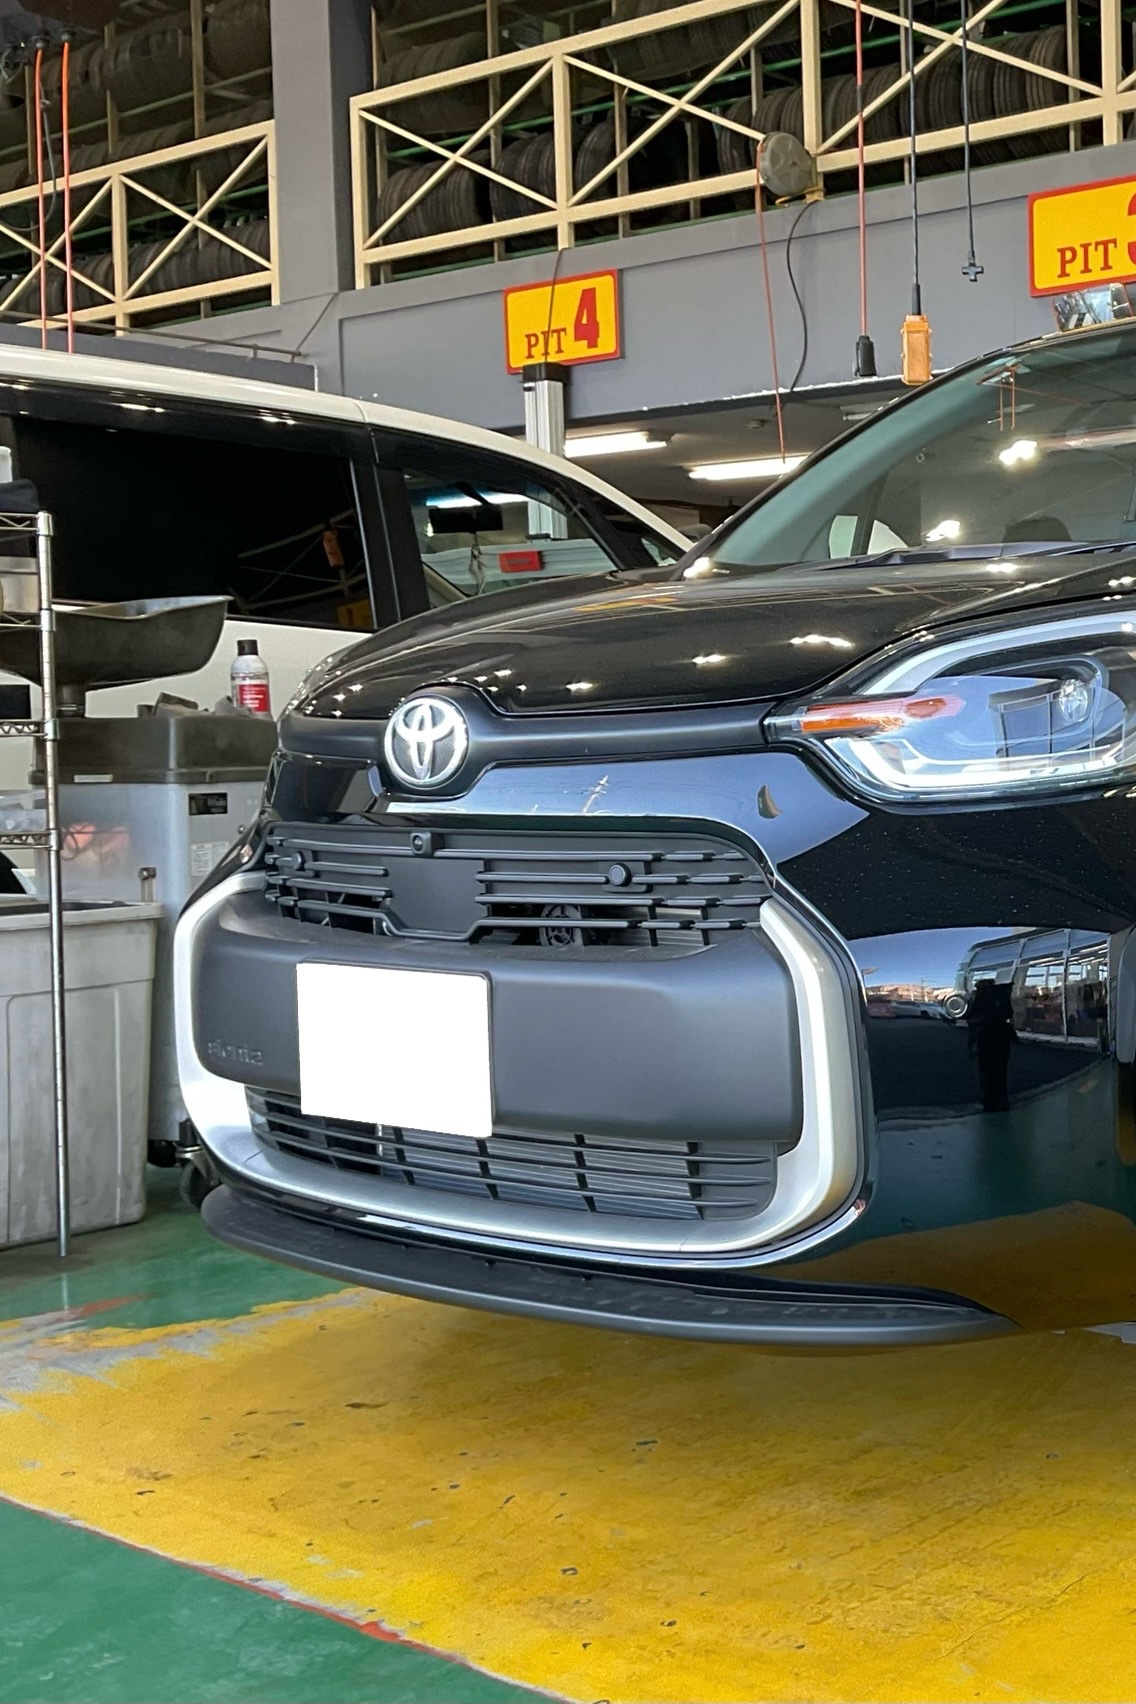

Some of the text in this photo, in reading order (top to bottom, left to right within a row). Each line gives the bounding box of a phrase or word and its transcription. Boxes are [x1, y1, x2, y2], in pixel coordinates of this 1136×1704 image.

[1057, 238, 1117, 278] PIT
[525, 287, 600, 359] PIT 4
